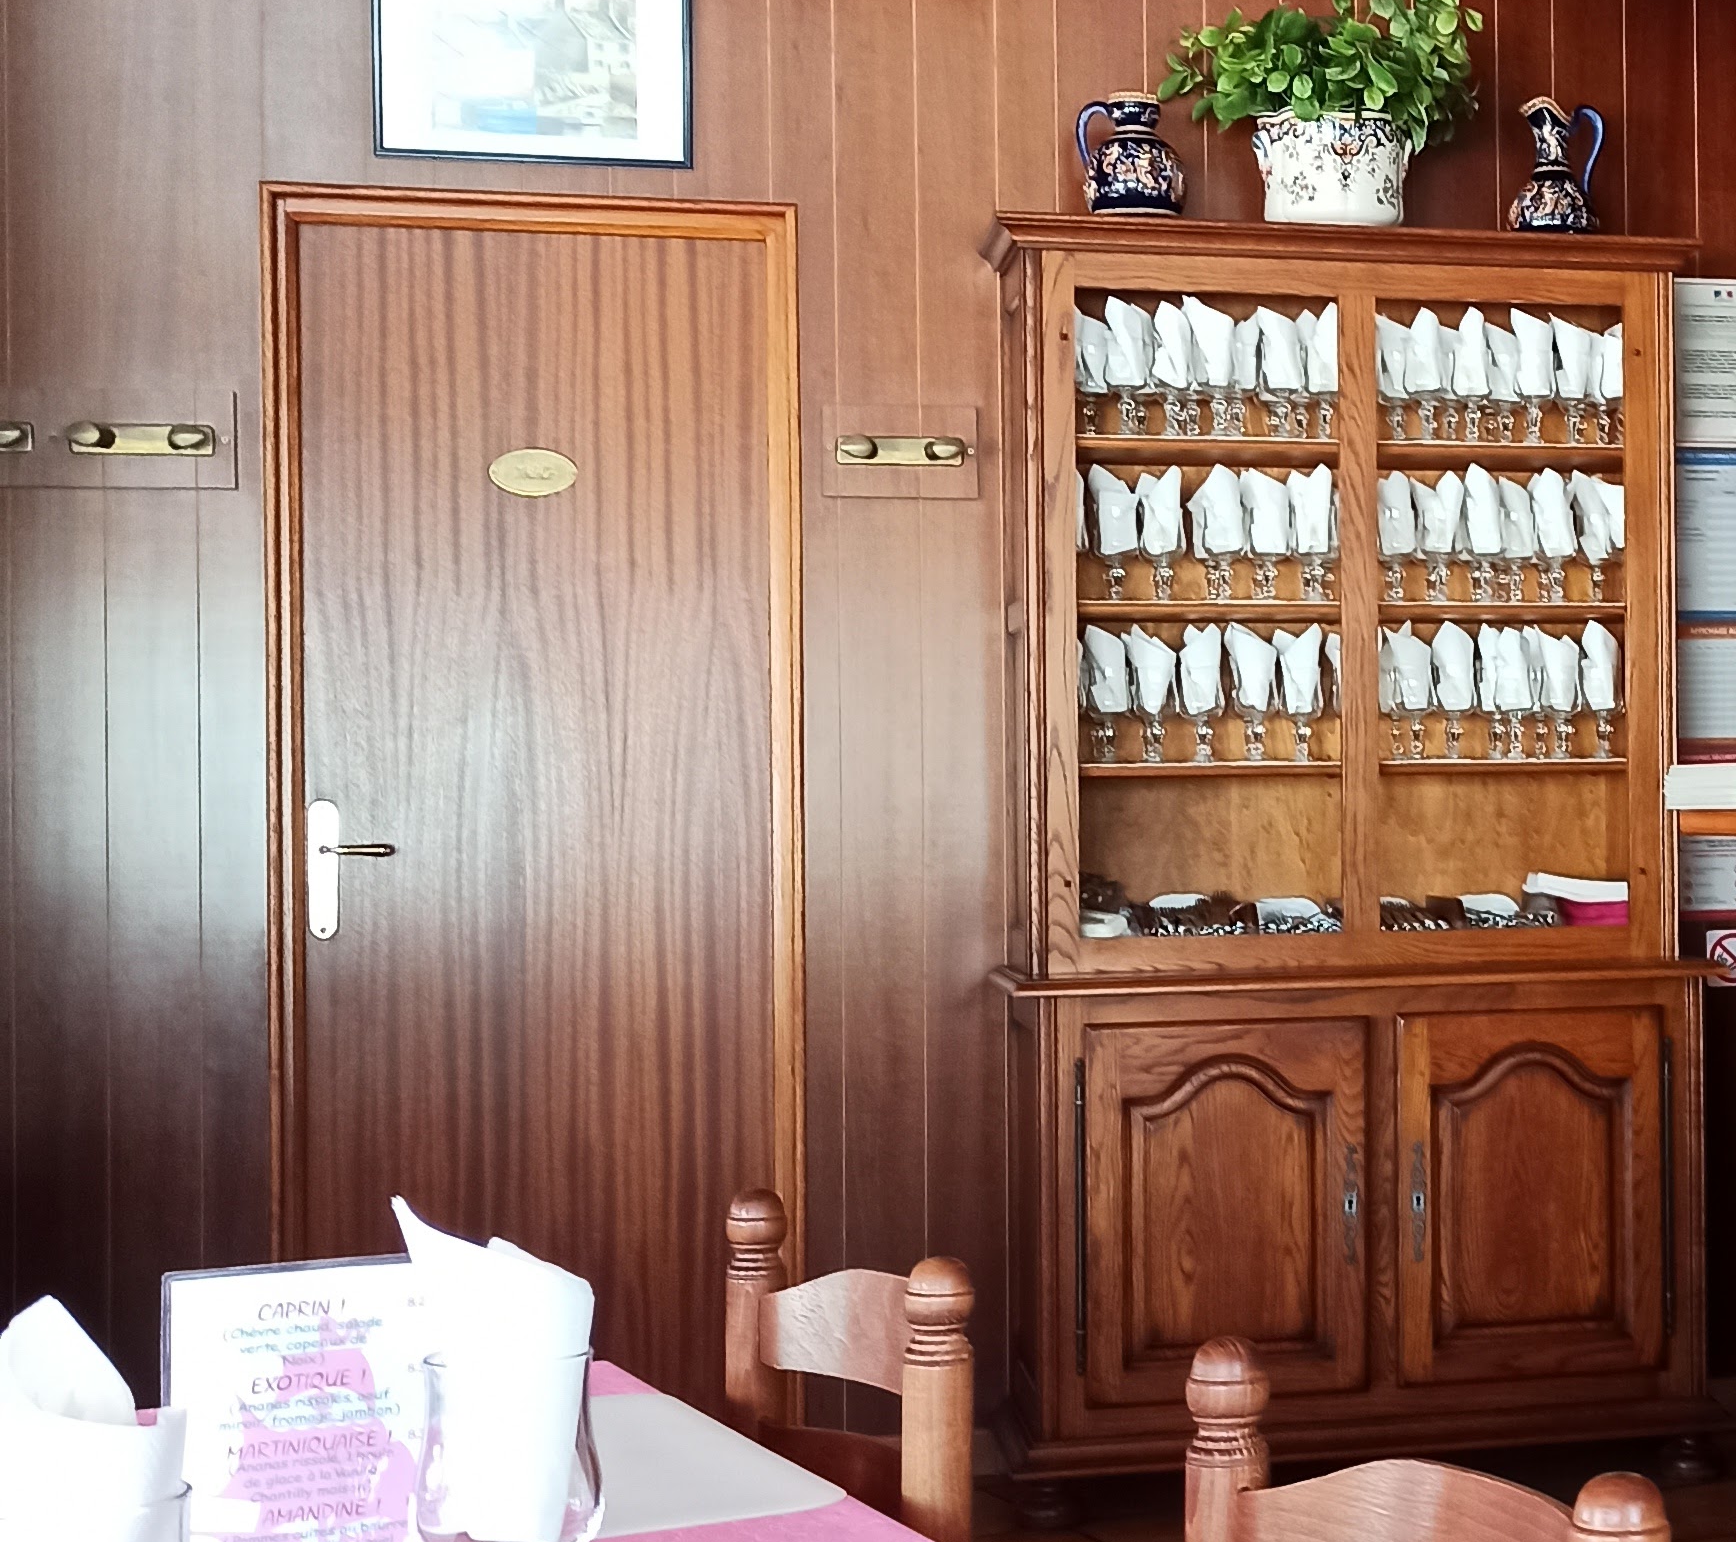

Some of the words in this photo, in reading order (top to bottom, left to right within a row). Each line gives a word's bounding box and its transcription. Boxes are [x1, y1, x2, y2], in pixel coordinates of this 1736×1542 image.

[257, 1298, 331, 1321] CAPRIN
[251, 1368, 352, 1395] EXOTIQUE
[226, 1429, 378, 1461] MARTINIQUAISE
[262, 1500, 366, 1527] AMANDINE
